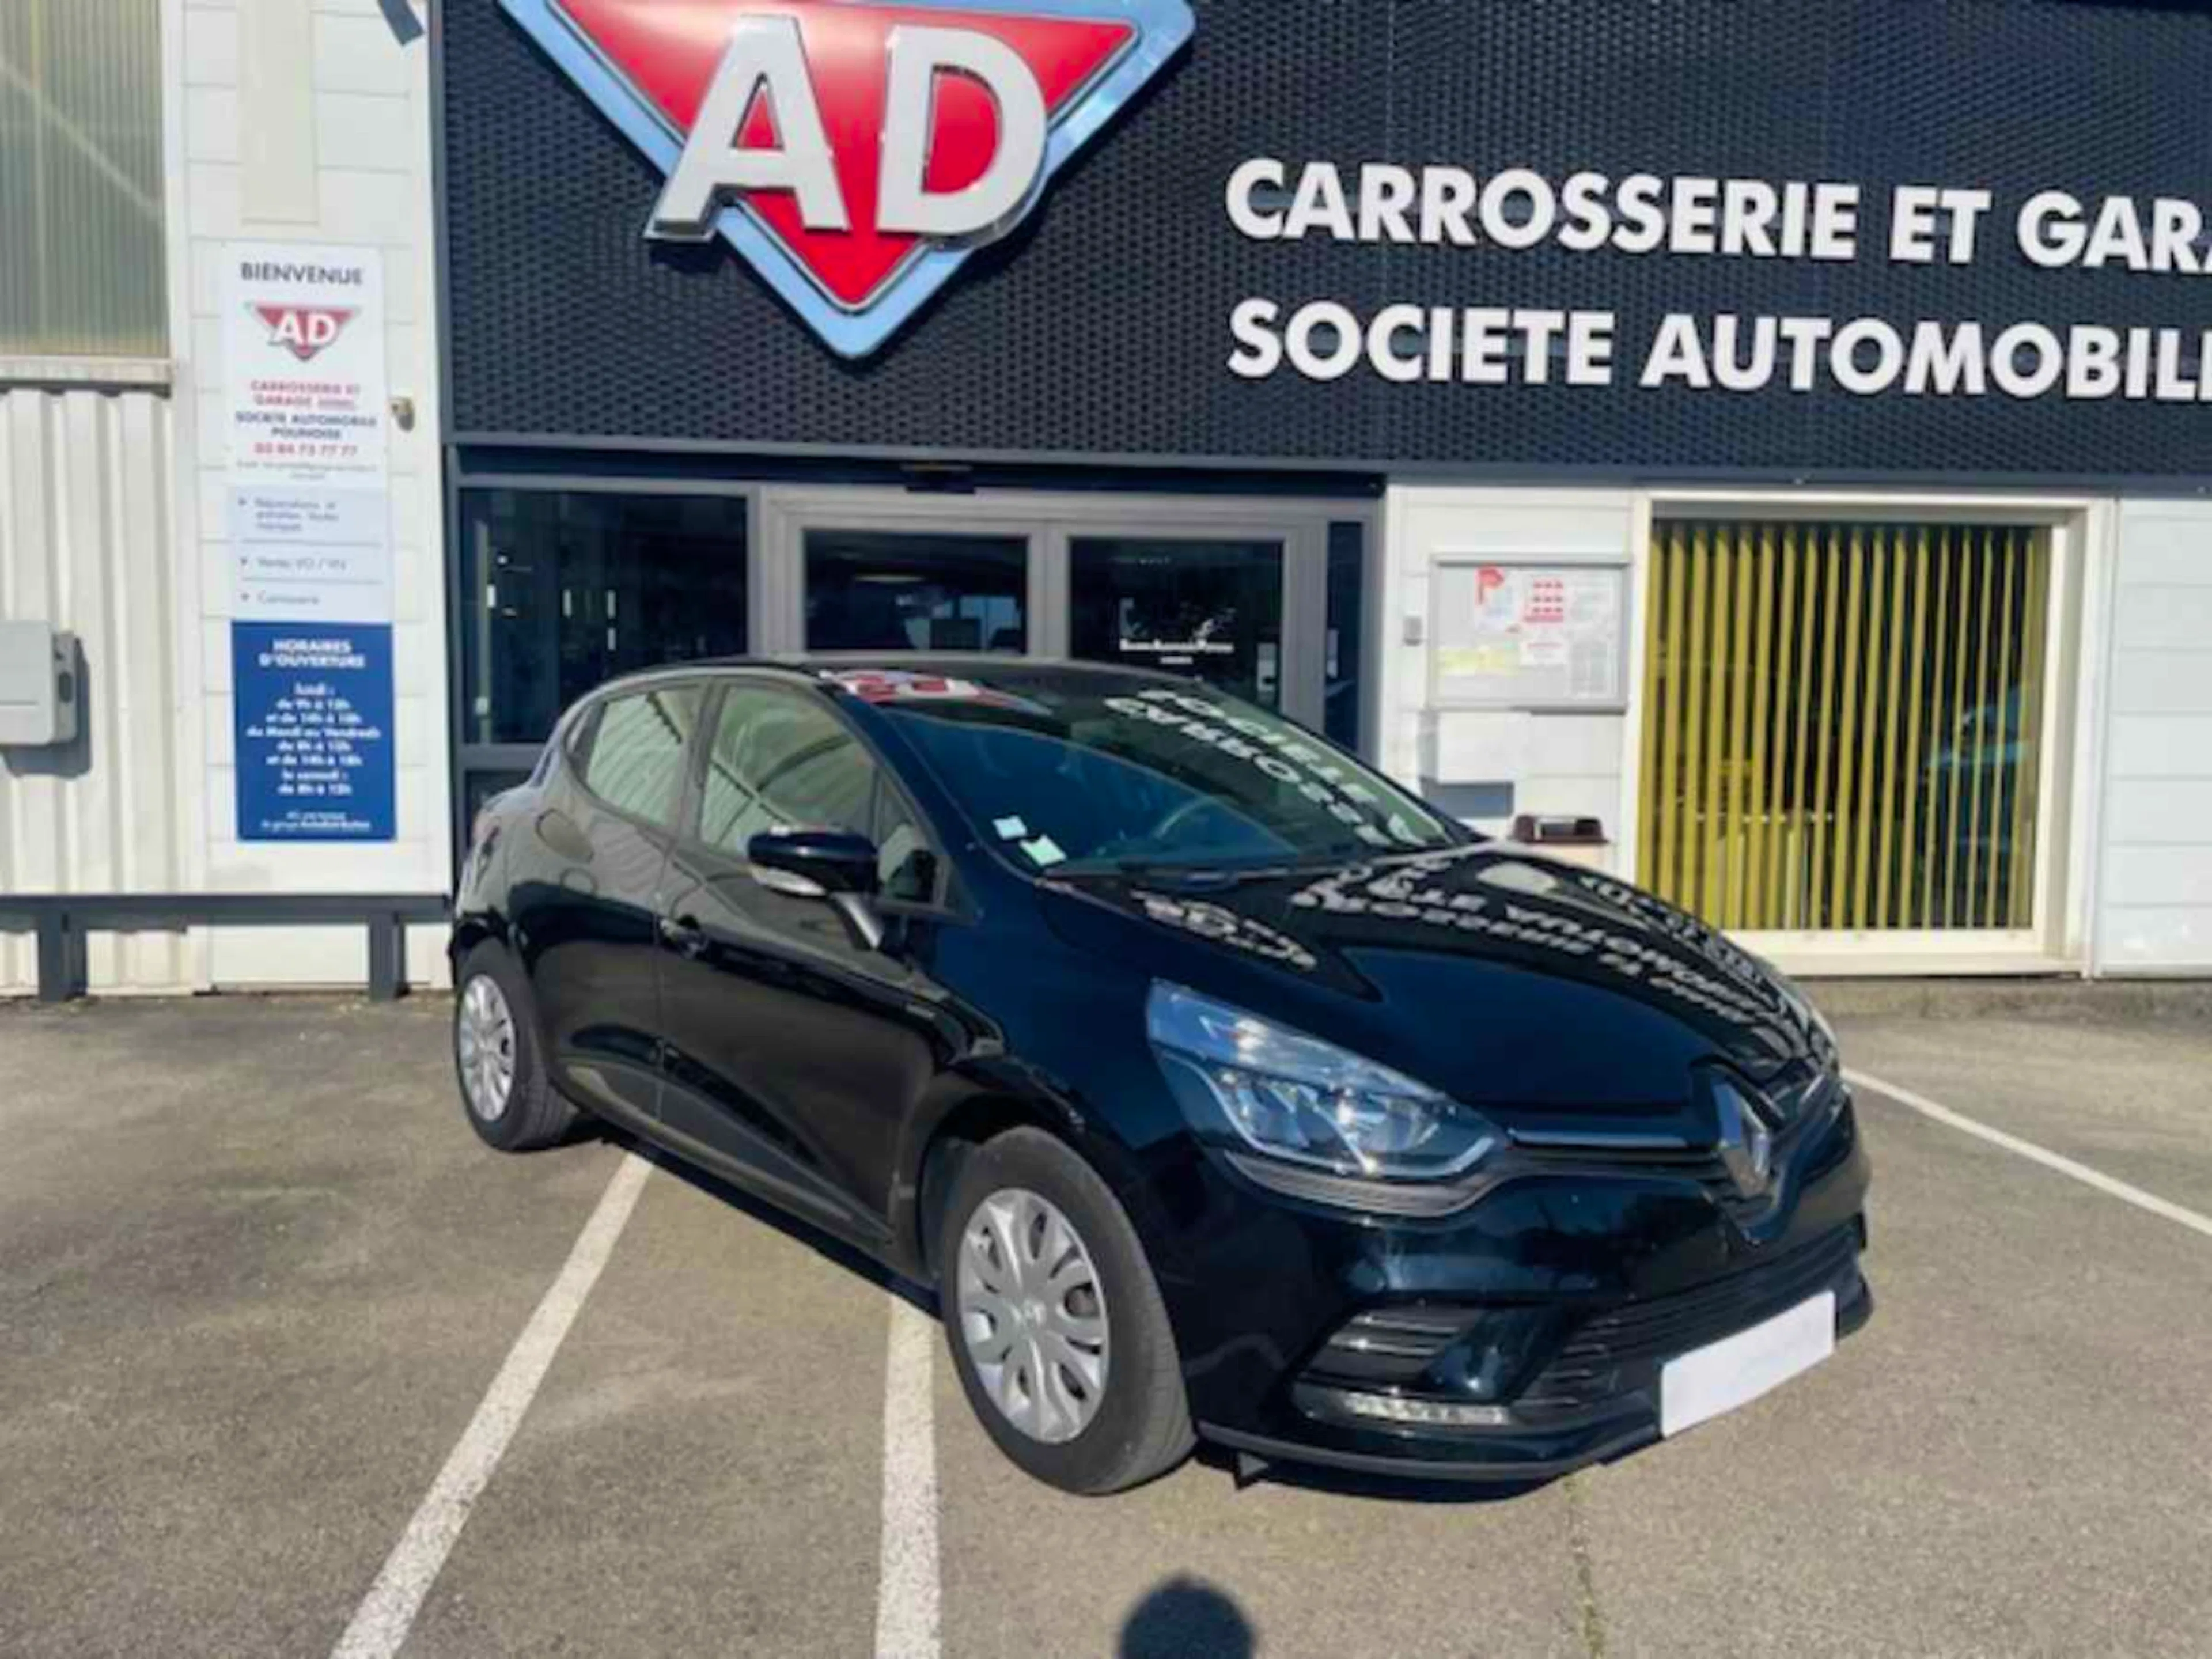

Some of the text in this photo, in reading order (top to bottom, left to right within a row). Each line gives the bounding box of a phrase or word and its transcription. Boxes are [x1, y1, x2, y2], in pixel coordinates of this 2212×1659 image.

[643, 13, 1047, 249] AD
[1226, 158, 2212, 274] CARROSSERIE ET GAR
[240, 262, 363, 285] BIENVENUE
[271, 311, 339, 344] AD
[1228, 298, 1614, 385] SOCIETE
[251, 380, 342, 394] CARROSSERIE
[253, 394, 312, 406] GARAGE
[236, 411, 377, 426] SOCIETE AUTOMOBILE
[272, 639, 352, 653] HORAIRES
[259, 653, 365, 668] D'OUVERTURE
